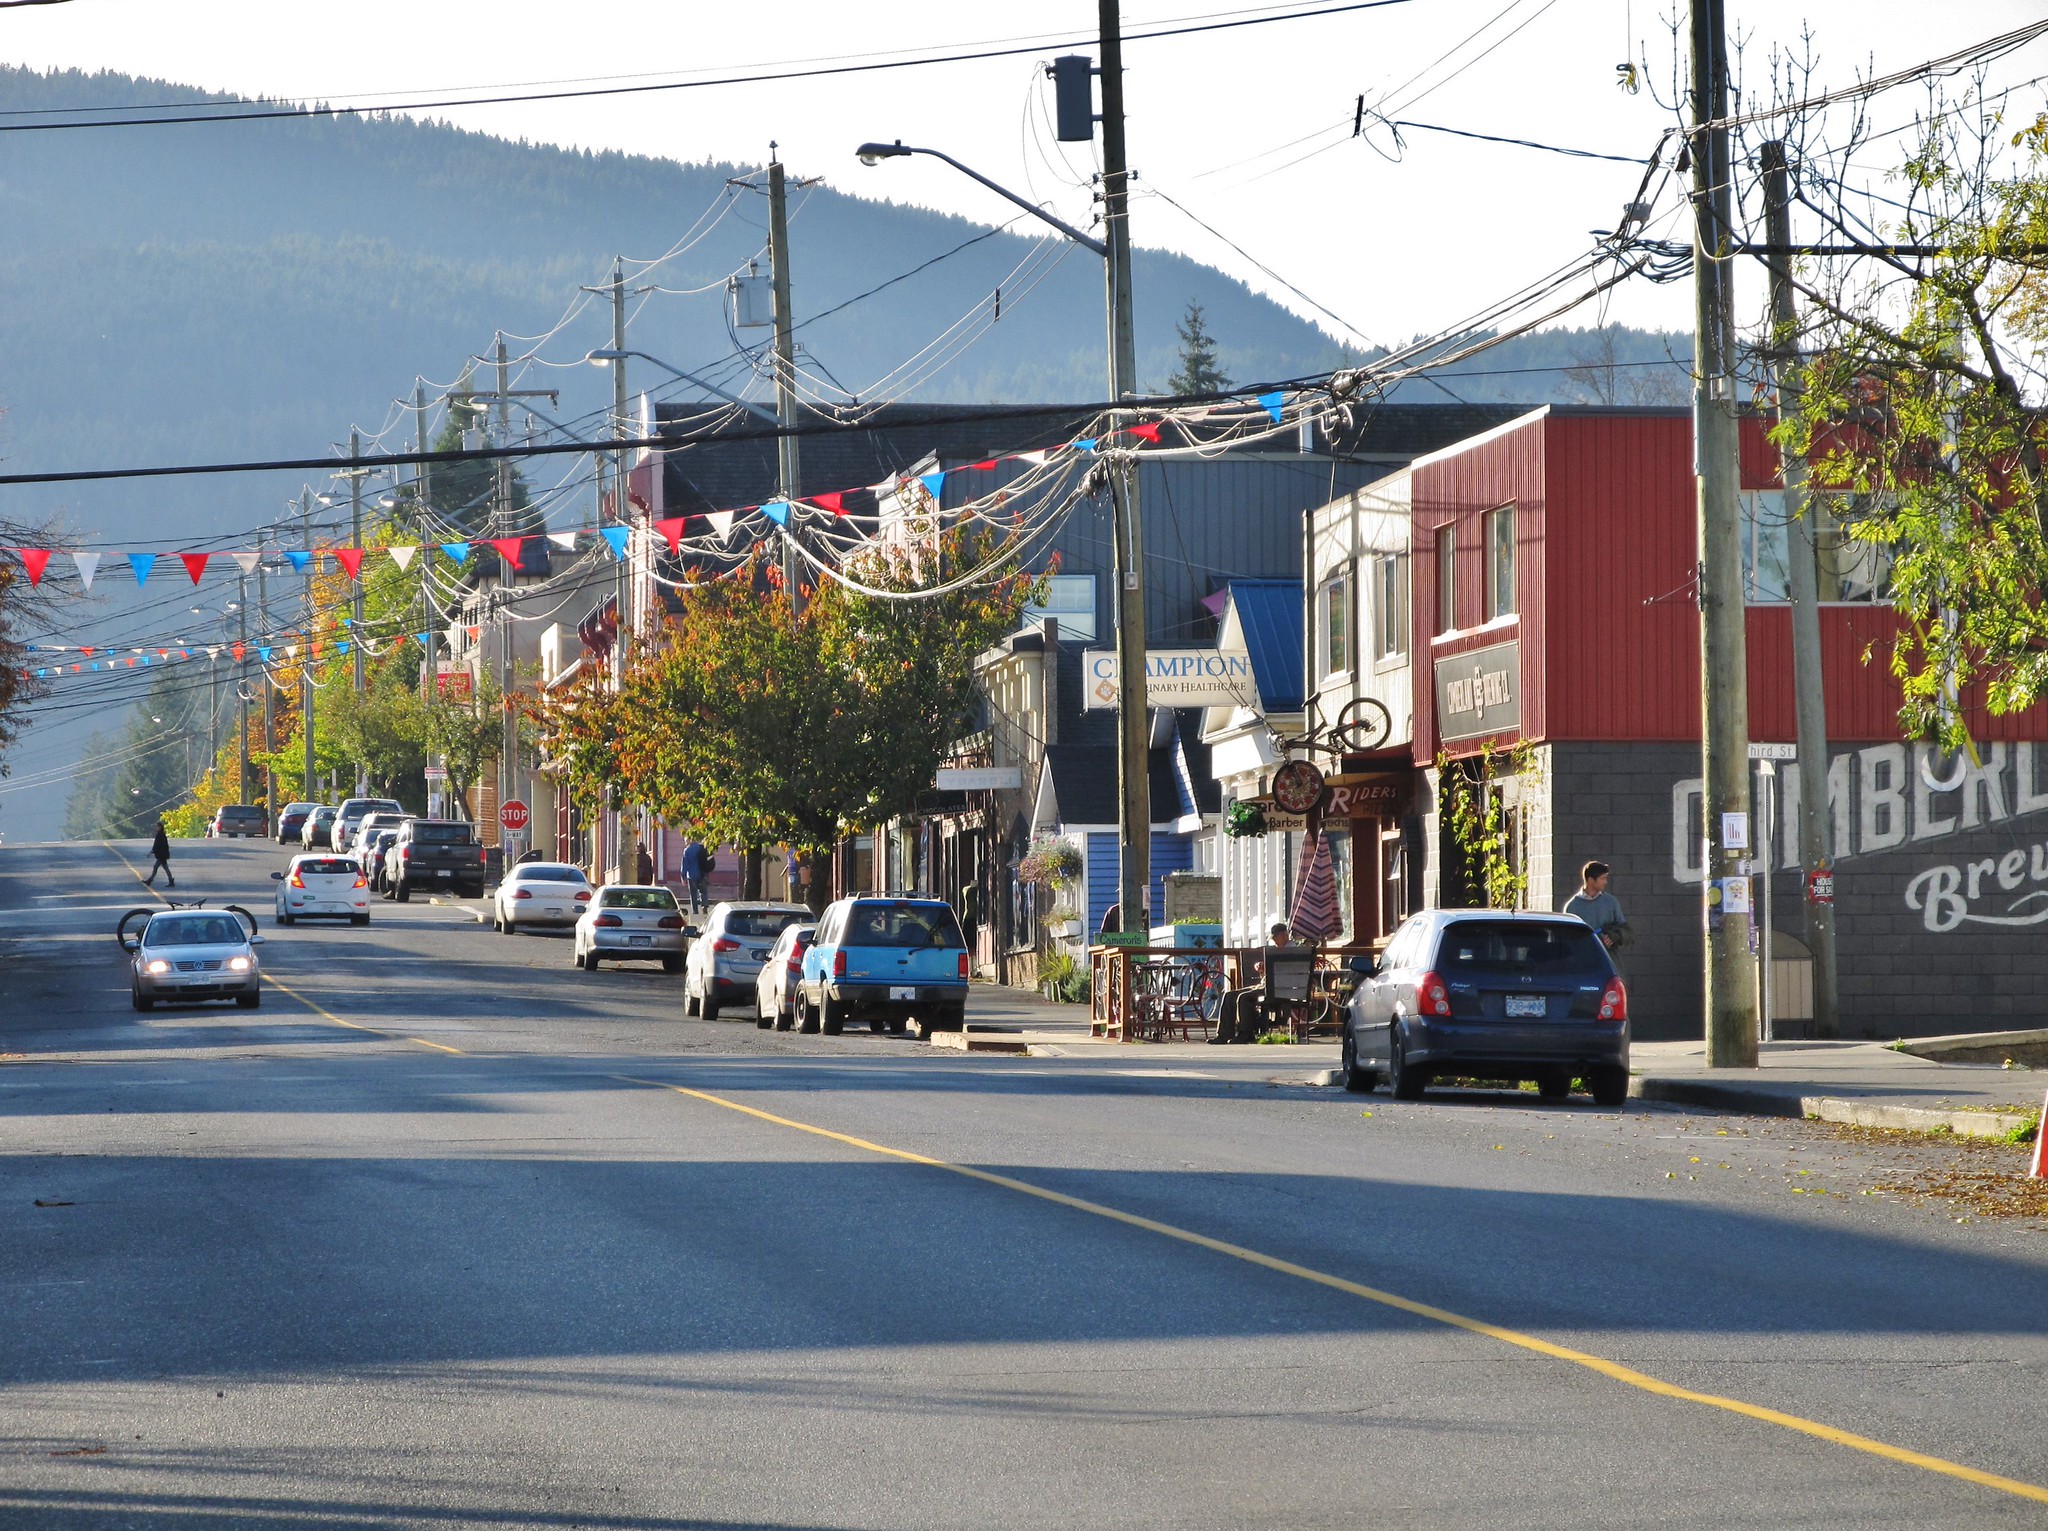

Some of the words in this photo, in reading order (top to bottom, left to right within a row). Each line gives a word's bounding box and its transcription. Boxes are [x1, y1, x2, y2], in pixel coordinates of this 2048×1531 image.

[1093, 655, 1249, 679] CAMPION
[1180, 681, 1247, 693] HEALTHCARE
[1748, 744, 1773, 757] hird
[1779, 744, 1792, 757] St
[1328, 785, 1397, 813] RIDERS
[500, 809, 528, 821] STOP
[918, 804, 966, 814] CHOCOLATES
[1269, 816, 1304, 829] Barber
[1816, 877, 1832, 886] HOUS
[1813, 885, 1825, 894] FOR
